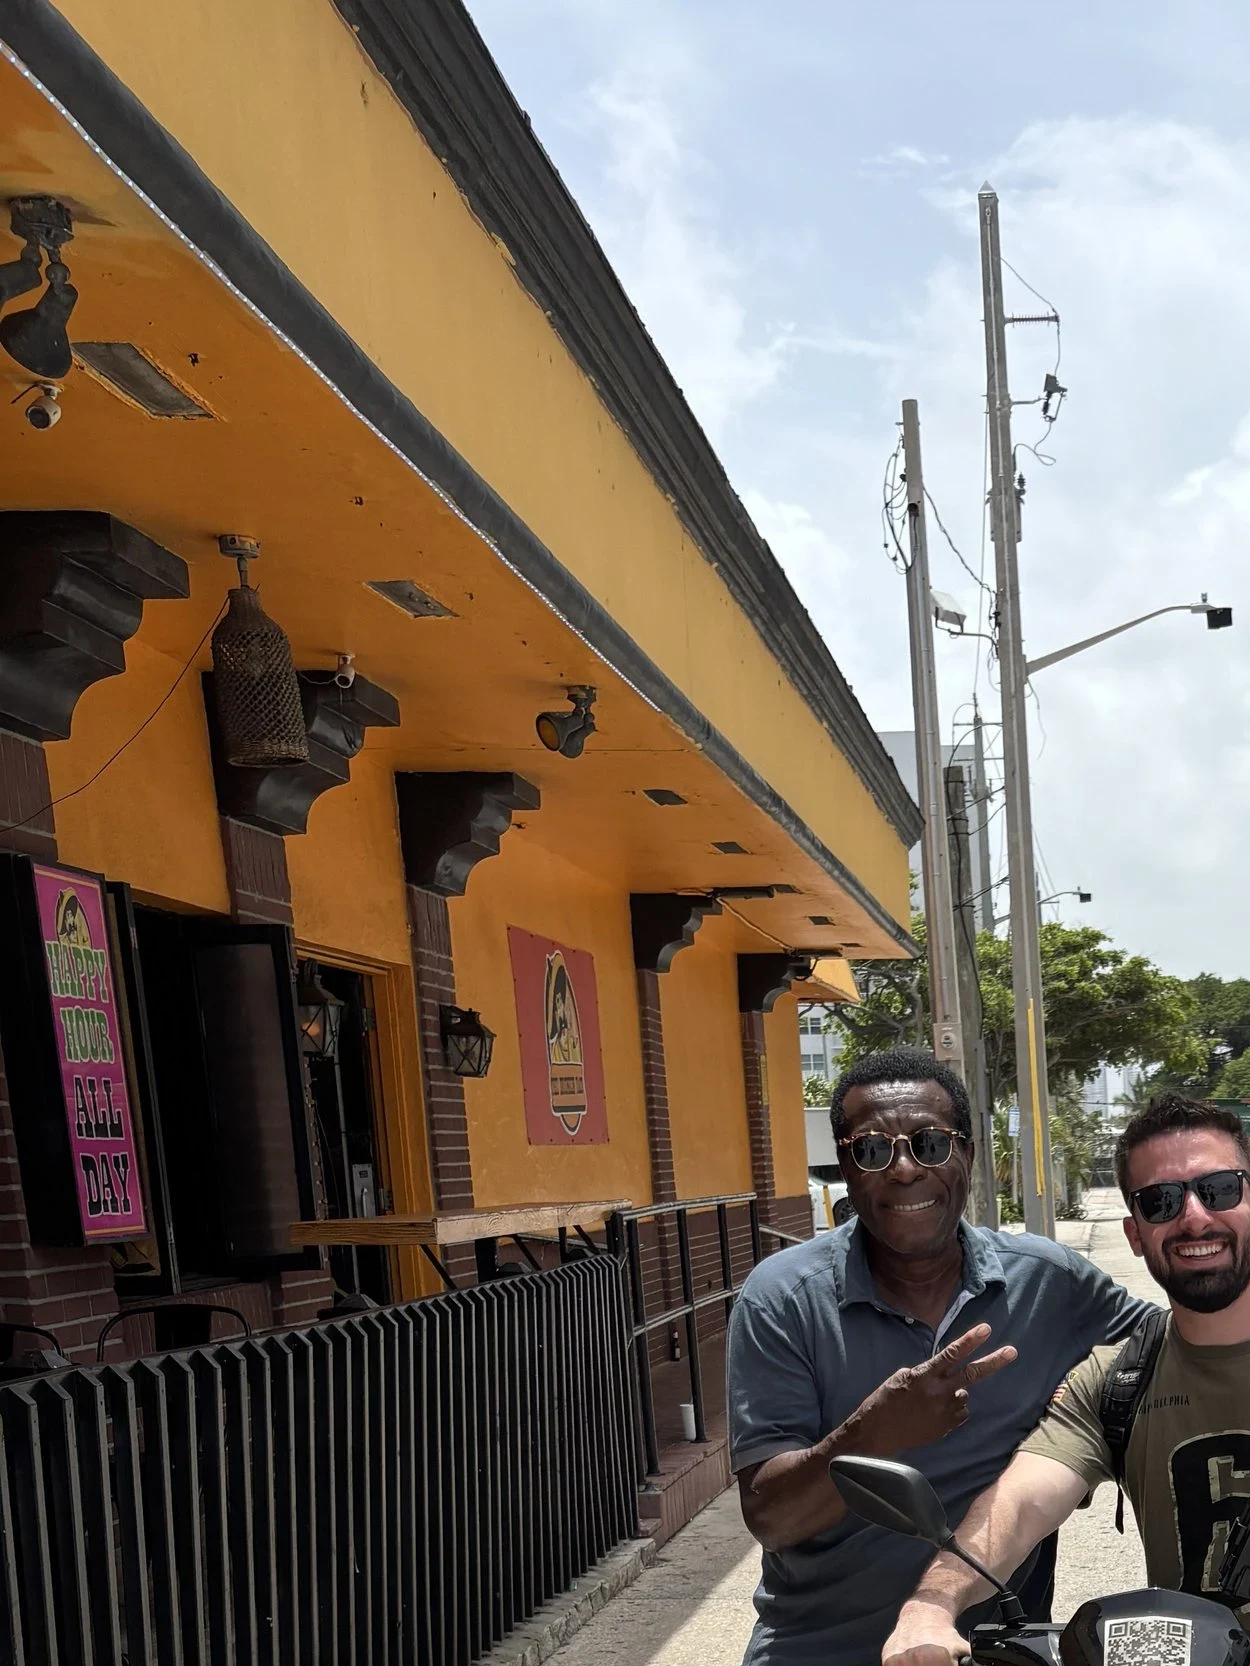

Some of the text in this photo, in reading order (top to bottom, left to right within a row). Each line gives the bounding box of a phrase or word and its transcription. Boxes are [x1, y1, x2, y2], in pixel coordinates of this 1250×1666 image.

[45, 941, 109, 1003] HAPPY
[60, 1006, 115, 1064] HOUR
[73, 1075, 125, 1140] ALL
[80, 1152, 132, 1217] DAY
